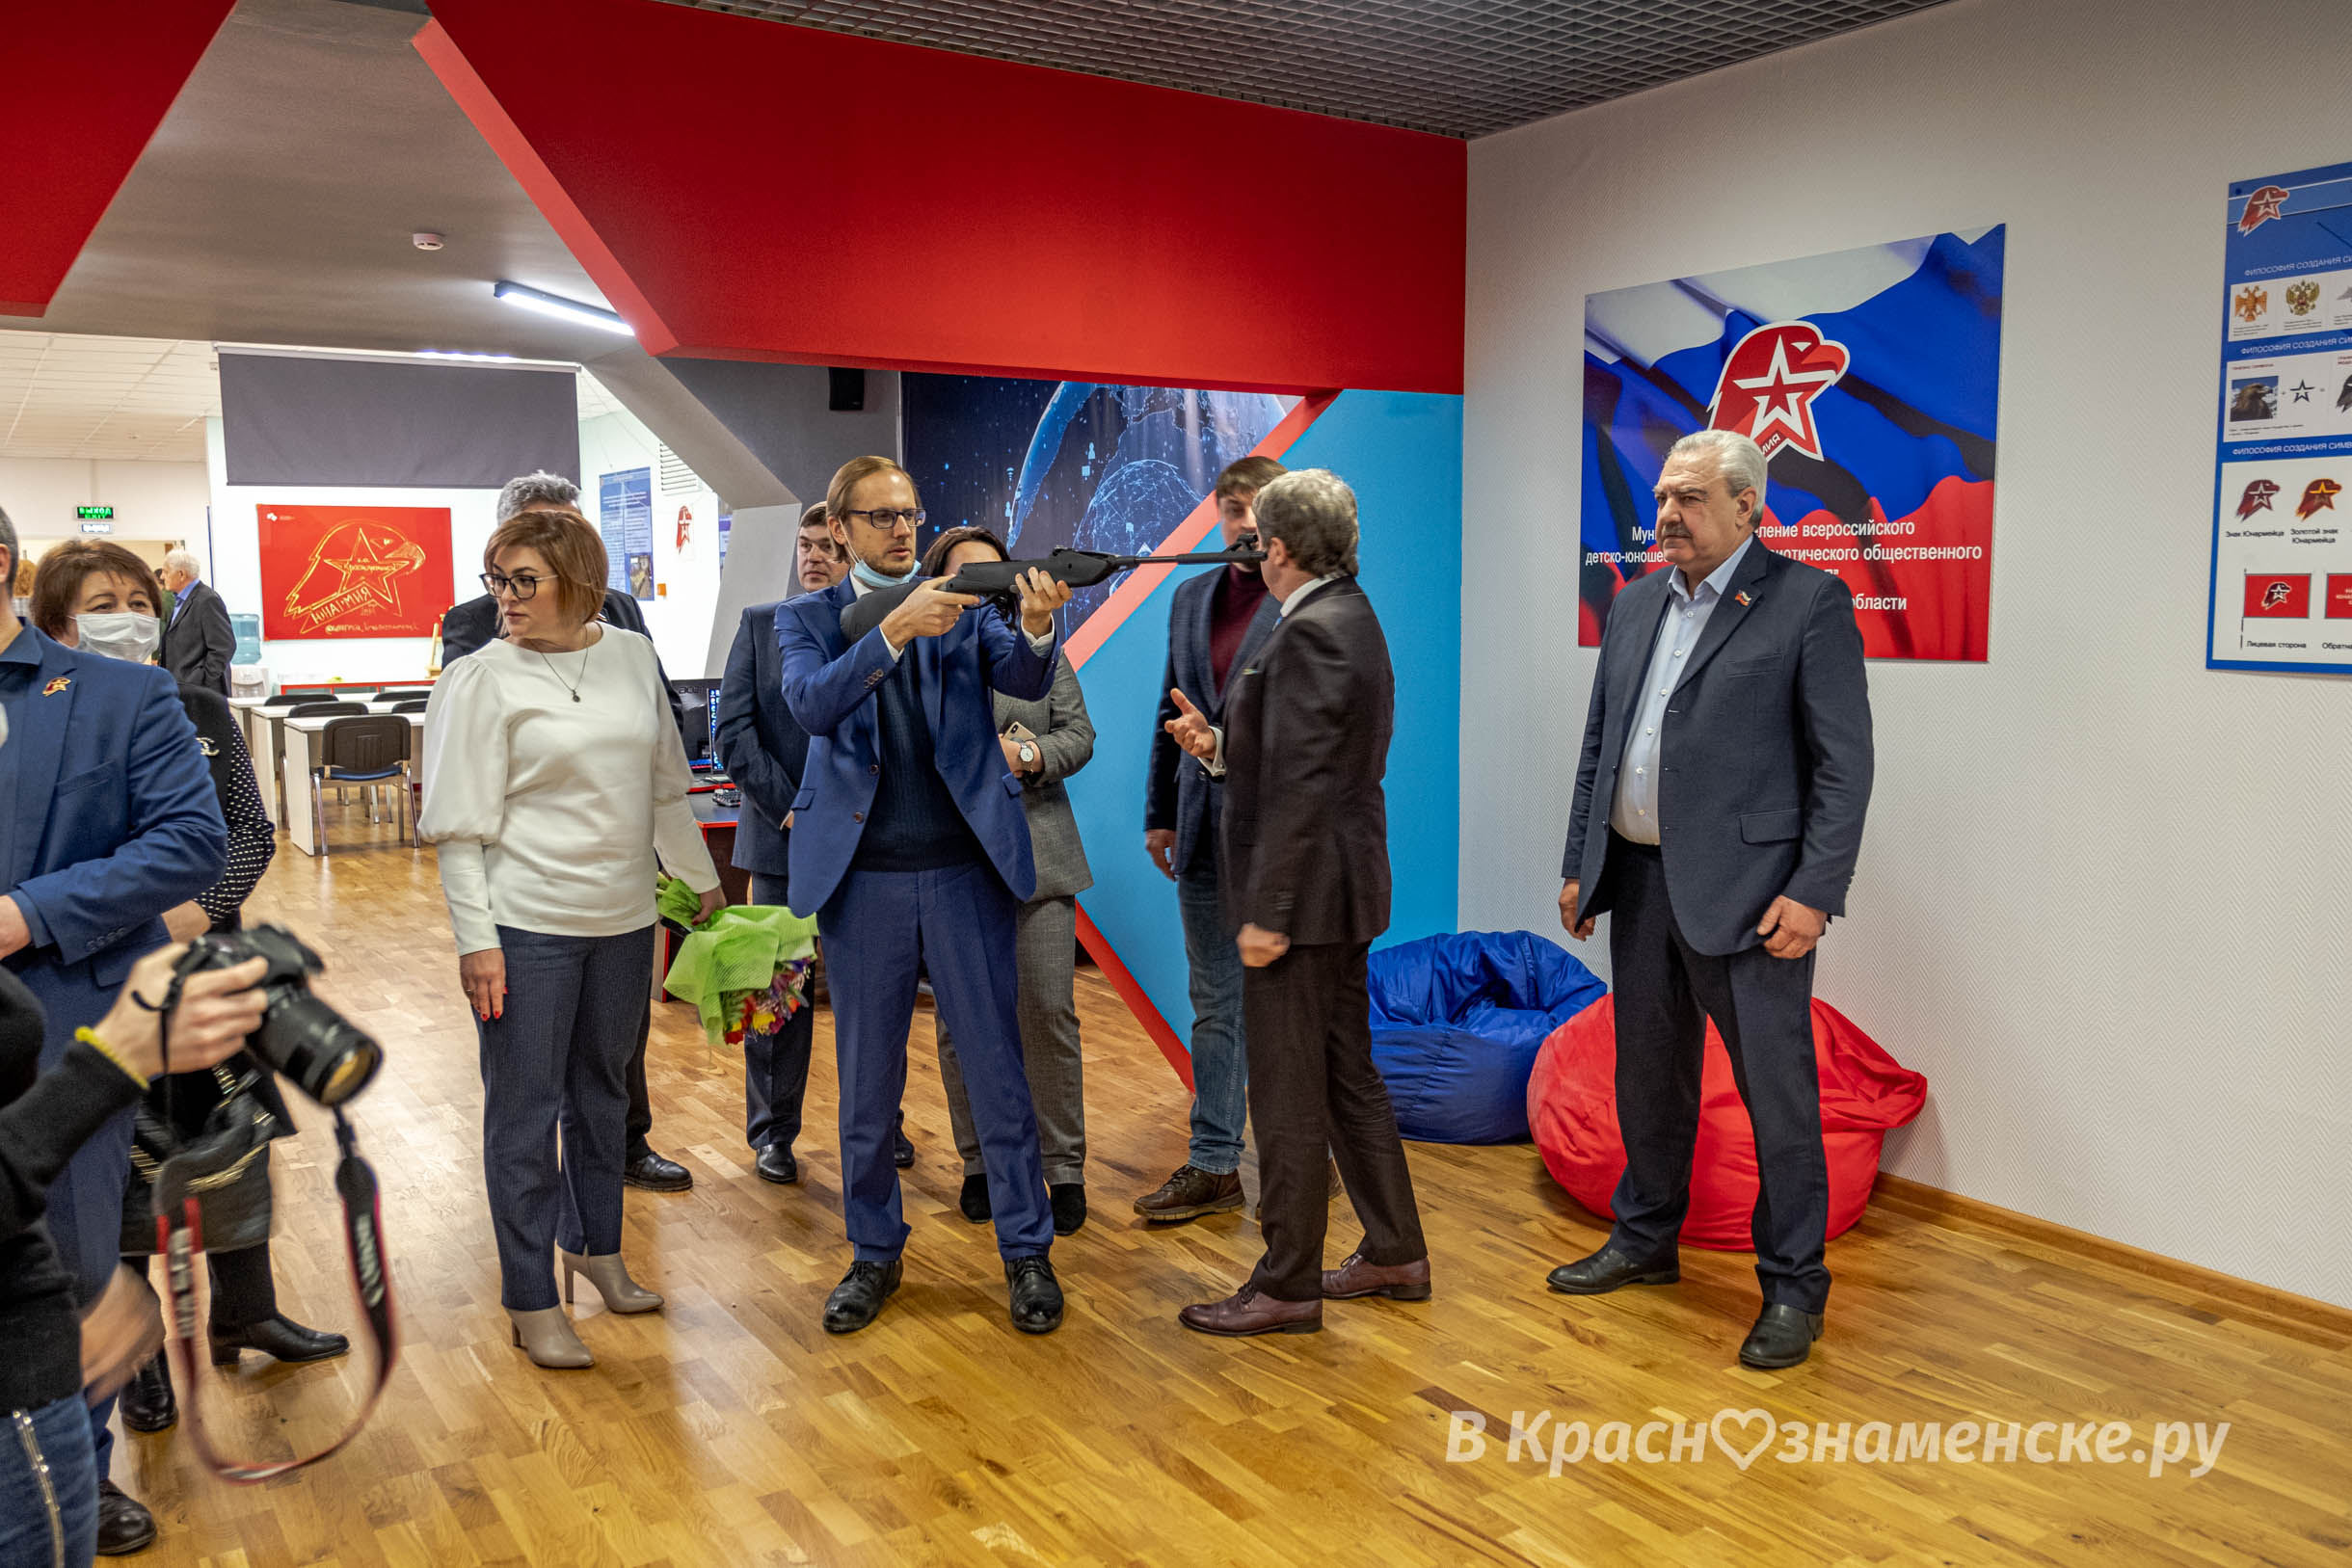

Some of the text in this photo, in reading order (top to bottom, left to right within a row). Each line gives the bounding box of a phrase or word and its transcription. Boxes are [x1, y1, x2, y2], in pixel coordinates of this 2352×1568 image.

[2244, 262, 2295, 277] ФИЛОСОФИЯ
[2296, 255, 2341, 270] СОЗДАНИЯ
[2240, 342, 2291, 355] ФИЛОСОФИЯ
[2292, 337, 2337, 350] СОЗДАНИЯ
[2232, 445, 2283, 455] ФИЛОСОФИЯ
[2283, 442, 2328, 453] СОЗДАНИЯ
[79, 507, 113, 517] ВЫХОД
[1803, 519, 1915, 540] всероссийского
[1863, 543, 1983, 564] общественного
